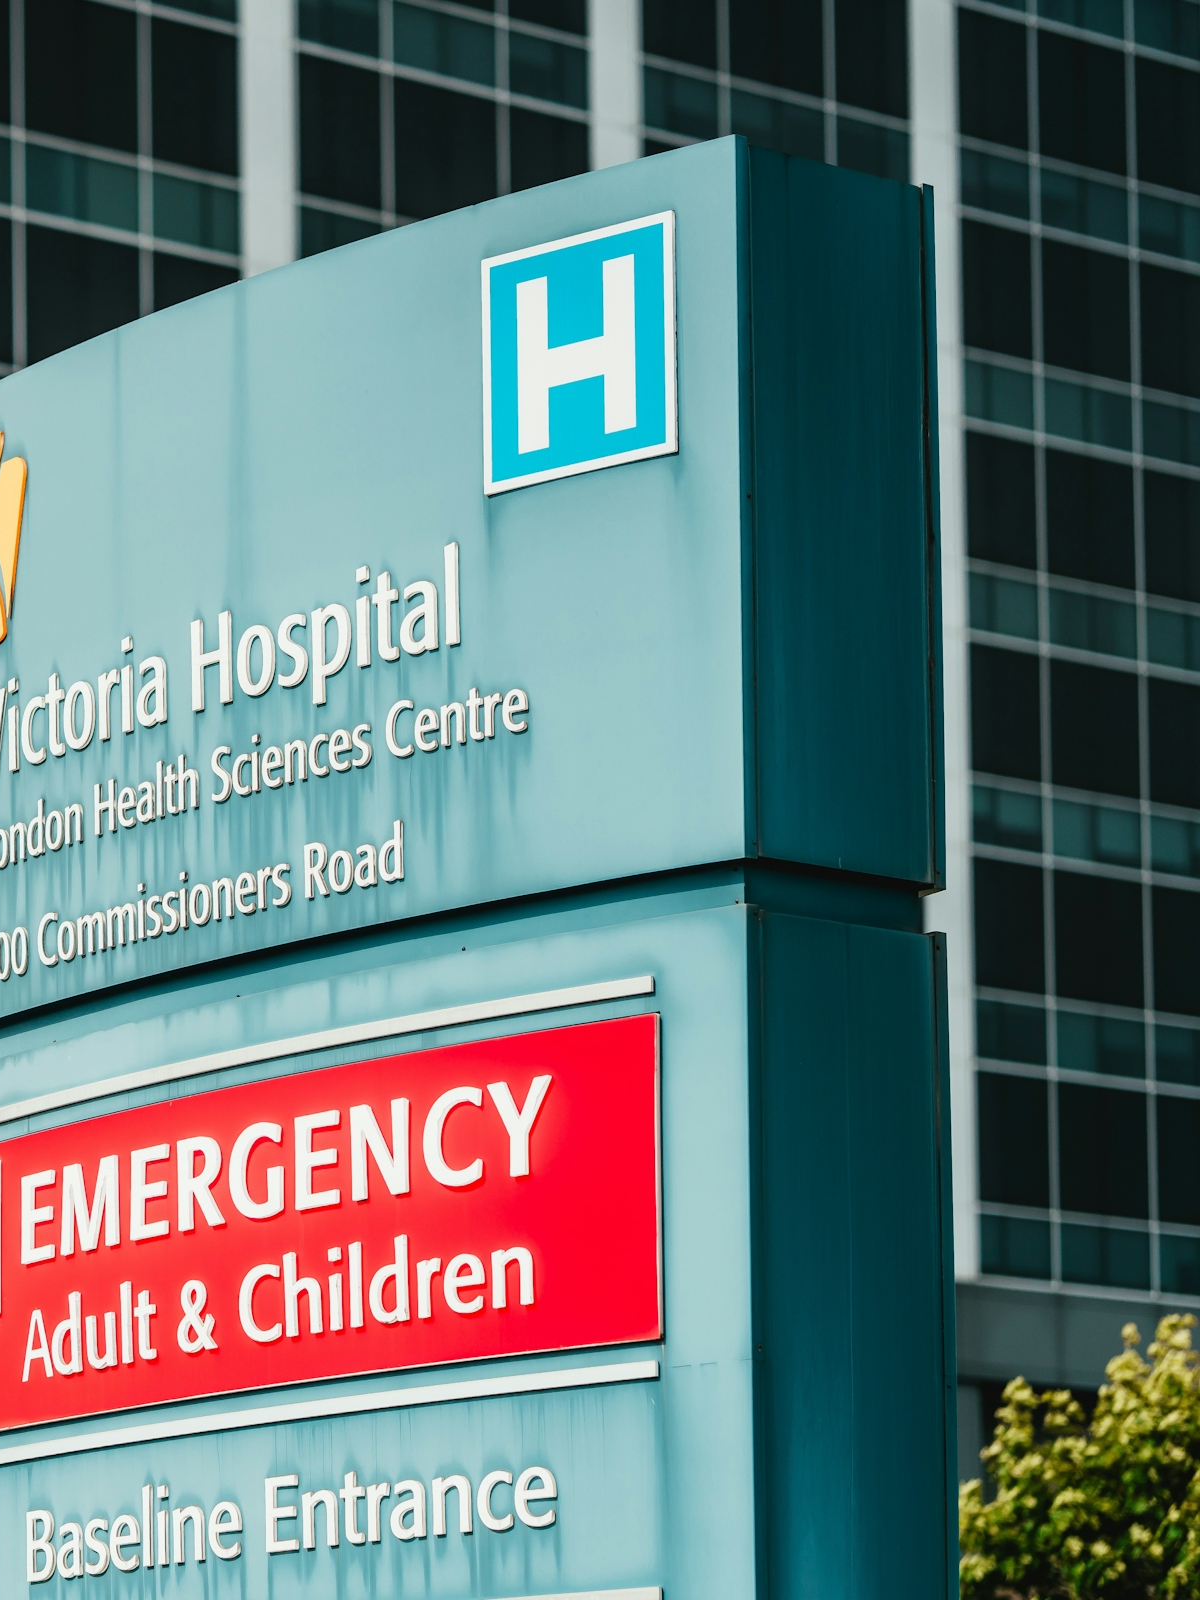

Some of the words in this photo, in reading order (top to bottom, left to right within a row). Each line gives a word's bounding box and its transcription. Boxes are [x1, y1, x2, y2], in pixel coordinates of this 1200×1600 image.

[516, 253, 637, 455] H
[191, 541, 460, 712] Hospital
[93, 754, 199, 836] Health
[211, 723, 372, 803] Sciences
[385, 687, 529, 757] Centre
[37, 861, 291, 966] Commissioners
[303, 819, 405, 899] Road
[20, 1074, 553, 1266] EMERGENCY
[20, 1280, 158, 1383] Adult
[176, 1279, 218, 1353] &
[238, 1233, 535, 1343] Children
[25, 1483, 244, 1584] Baseline
[265, 1465, 557, 1554] Entrance
